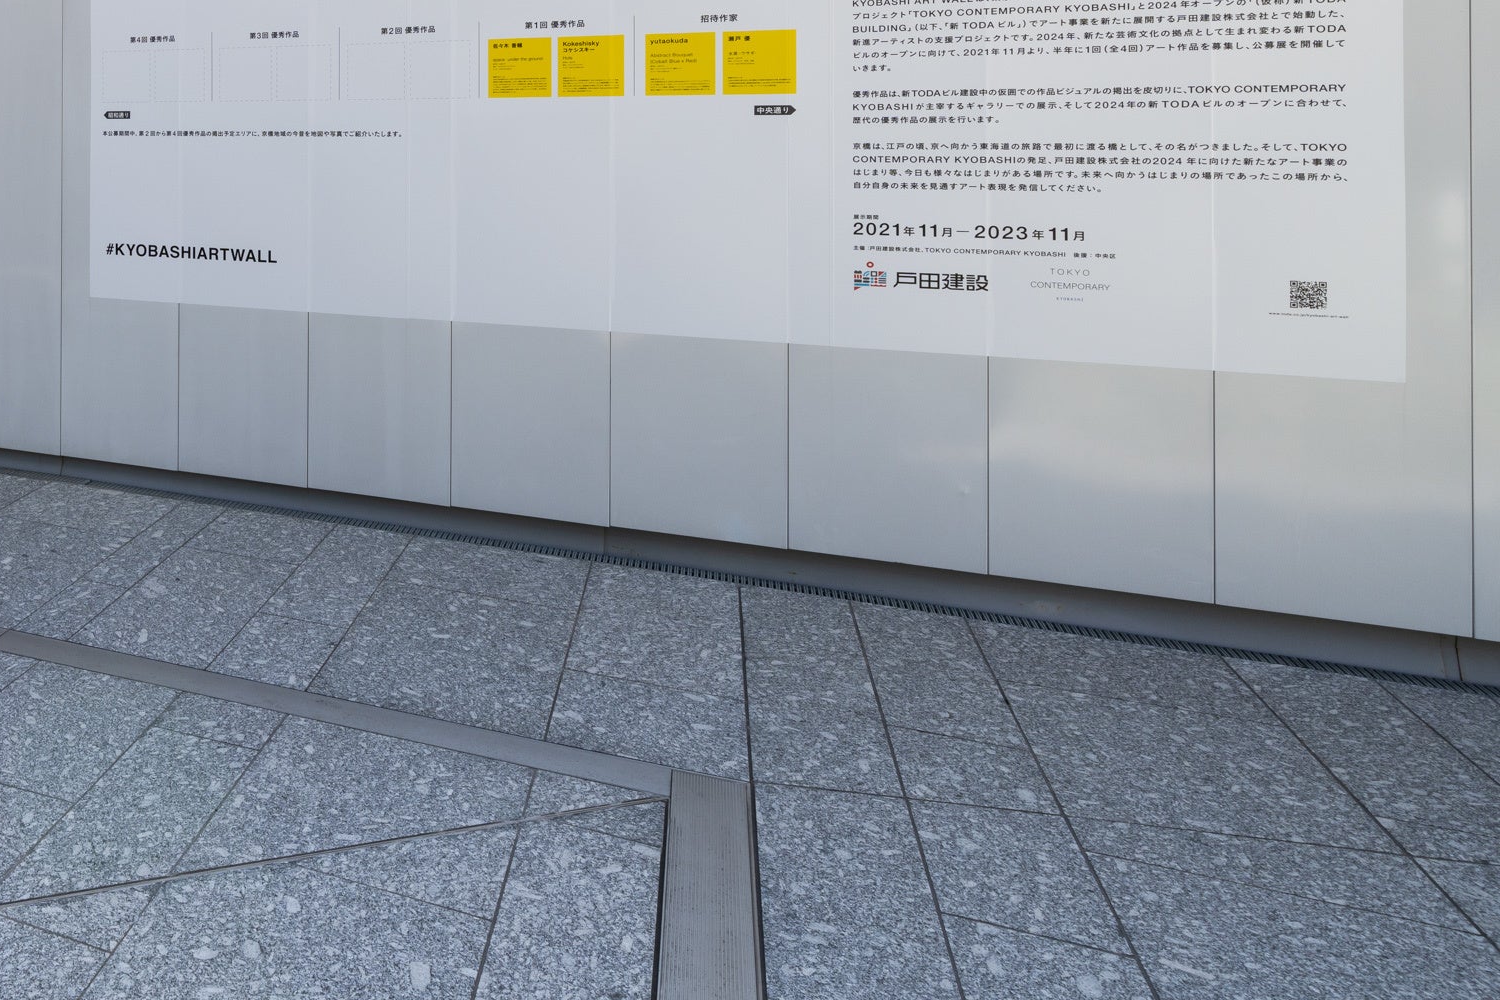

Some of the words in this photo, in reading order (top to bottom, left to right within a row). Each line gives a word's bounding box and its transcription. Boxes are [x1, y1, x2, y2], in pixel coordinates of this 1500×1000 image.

[957, 4, 1060, 16] CONTEMPORARY
[700, 14, 738, 23] 招待作家
[380, 26, 403, 35] 第2回
[404, 25, 436, 34] 優秀作品
[524, 21, 548, 30] 第1回
[550, 20, 585, 29] 優秀作品
[149, 35, 176, 43] 優秀作品
[249, 31, 269, 40] 第3回
[271, 30, 300, 39] 優秀作品
[650, 38, 688, 46] yutaokuda
[852, 64, 892, 73] いきます。
[1234, 84, 1347, 93] CONTEMPORARY
[756, 106, 789, 114] 中央通り
[852, 155, 950, 164] CONTEMPORARY
[105, 243, 278, 264] #KYOBASHIARTWALL
[953, 248, 1021, 256] CONTEMPORARY
[1023, 250, 1066, 258] KYOBASHI
[1050, 267, 1091, 277] TOKYO
[893, 271, 989, 292] 戸田建設
[1030, 280, 1111, 292] CONTEMPORARY
